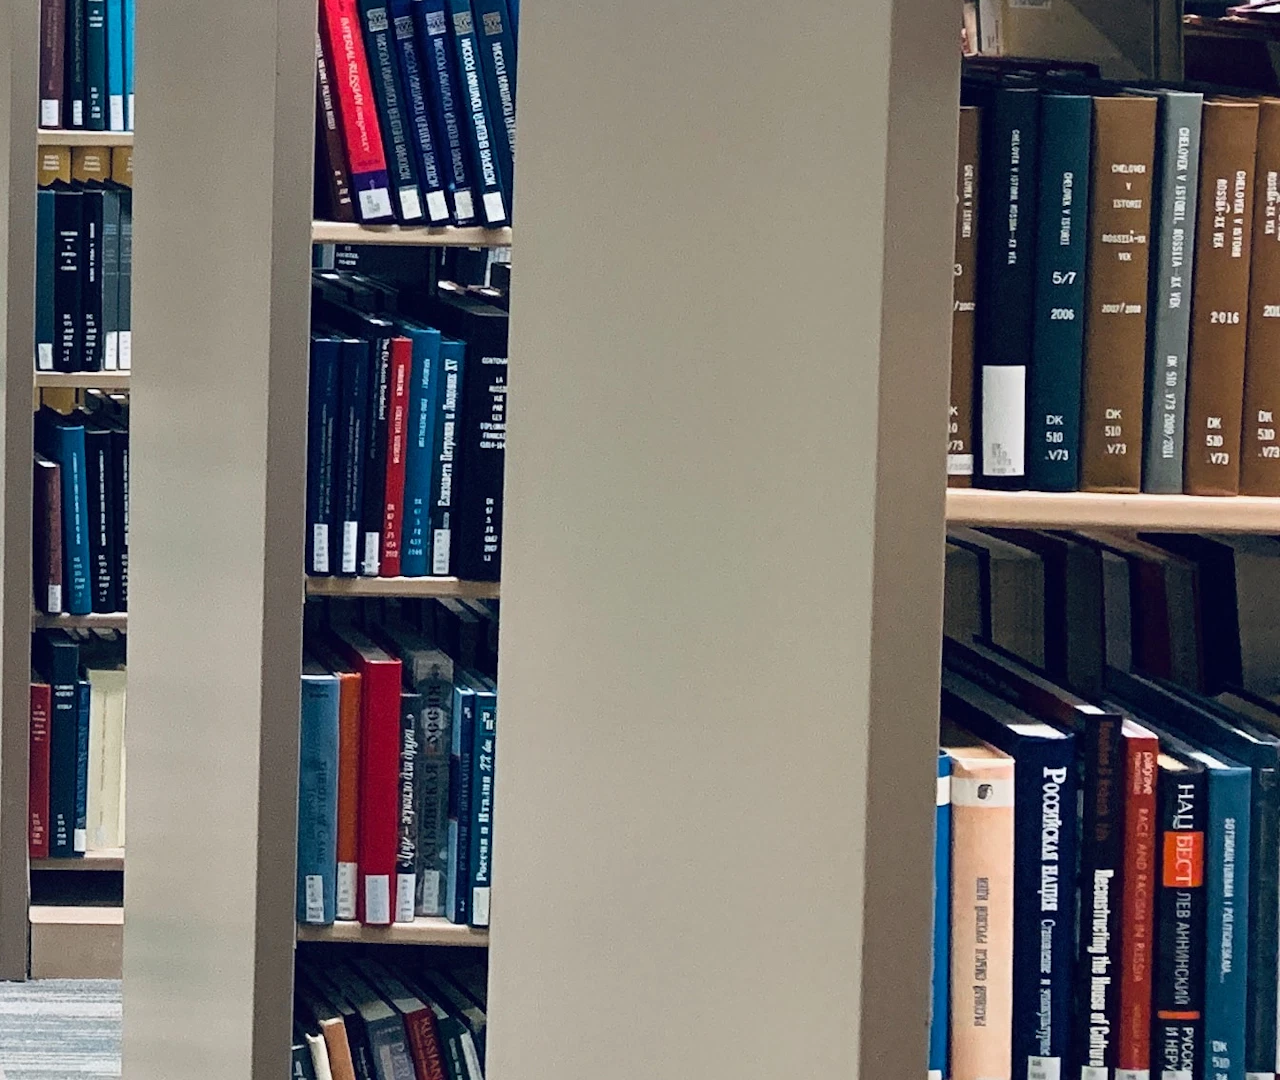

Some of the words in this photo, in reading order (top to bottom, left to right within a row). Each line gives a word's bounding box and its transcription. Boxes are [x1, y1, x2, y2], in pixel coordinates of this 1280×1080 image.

[1052, 272, 1076, 284] 5/7
[1051, 308, 1075, 320] 2006
[1210, 311, 1239, 324] 2016
[1046, 415, 1063, 425] DK
[1046, 431, 1063, 443] 510
[1045, 449, 1069, 461] .V73
[1173, 784, 1193, 830] НАЦ
[1175, 835, 1193, 884] БЕСТ
[1087, 870, 1114, 953] Reconstructing
[1176, 892, 1191, 918] ЛЕВ
[1091, 956, 1111, 974] the
[1174, 922, 1191, 1006] АННИНСКИЙ
[1090, 976, 1111, 1011] House
